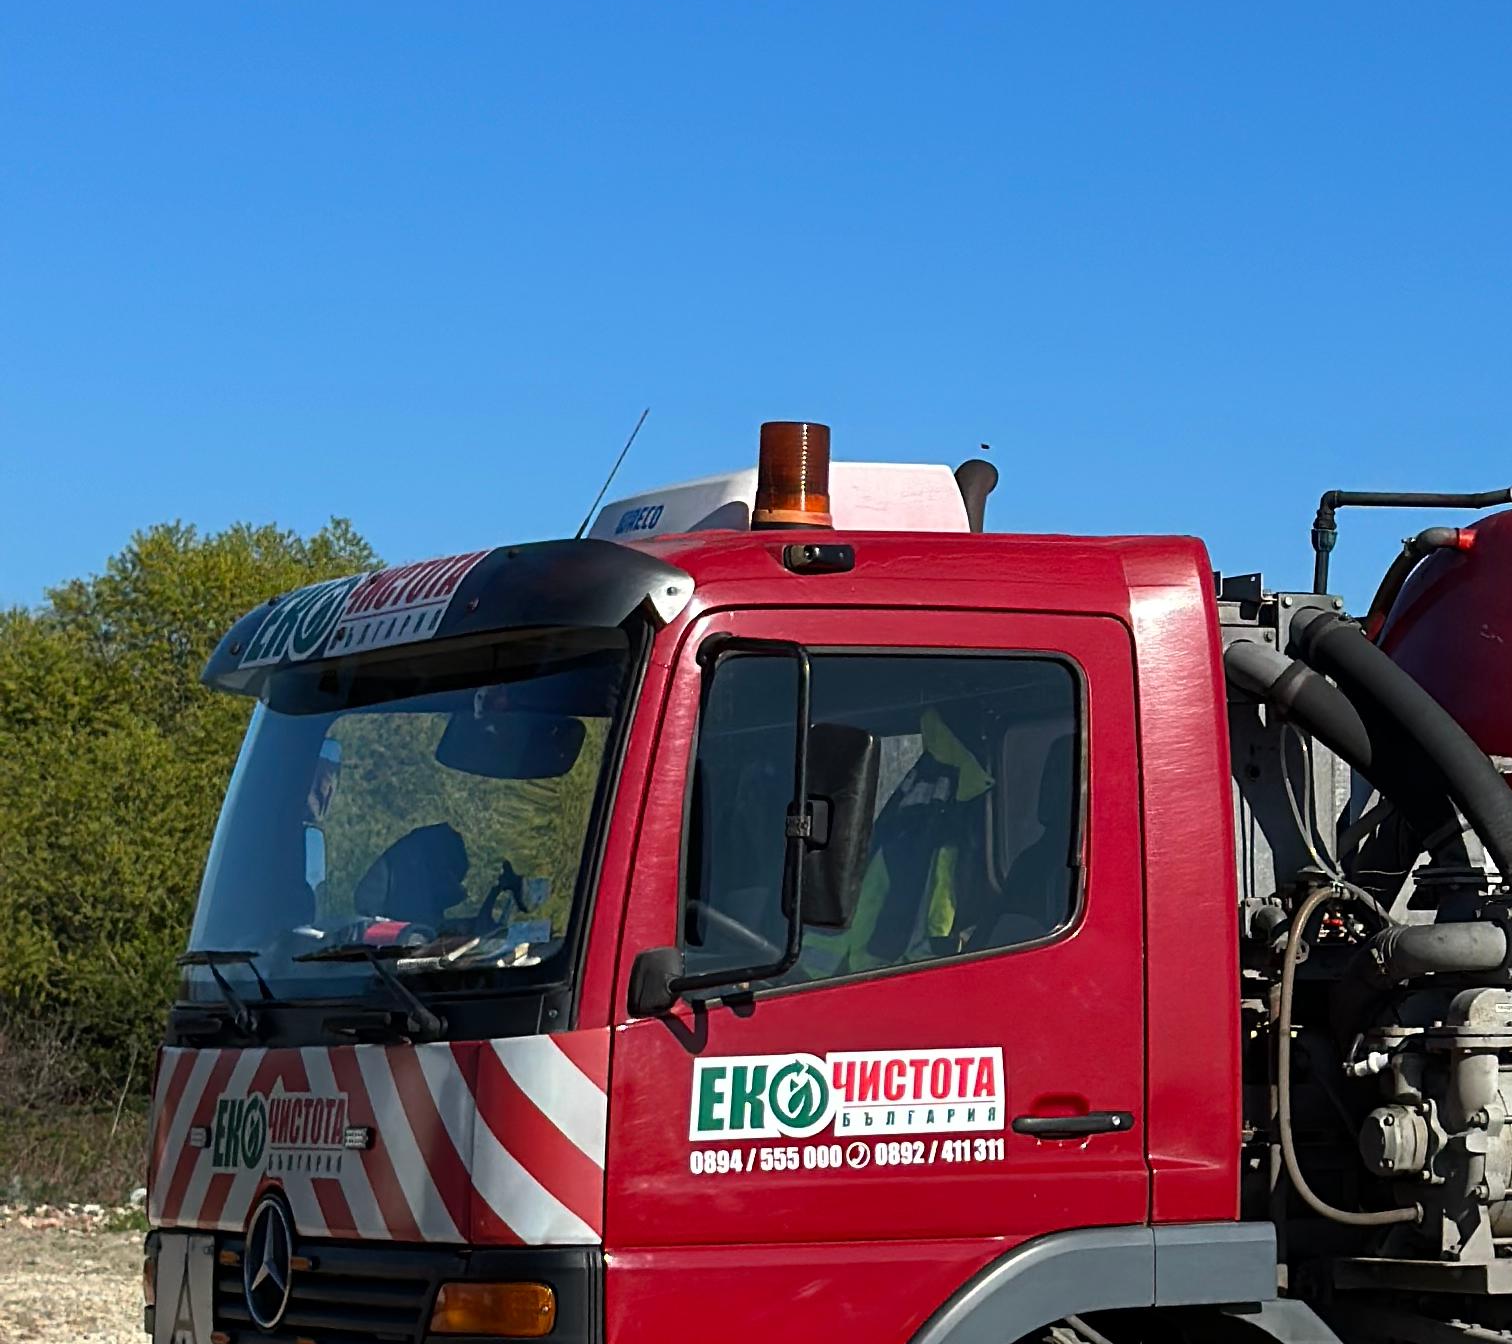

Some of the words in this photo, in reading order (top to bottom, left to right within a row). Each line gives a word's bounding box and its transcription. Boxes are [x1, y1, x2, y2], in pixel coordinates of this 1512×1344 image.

[697, 1059, 829, 1131] ЕКО
[832, 1057, 996, 1102] ЧИСТОТА
[843, 1107, 996, 1127] БЪЛГАРИЯ
[212, 1095, 267, 1169] ЕКО
[268, 1098, 345, 1144] ЧИСТОТА
[690, 1149, 743, 1174] 0894
[760, 1148, 800, 1171] 555
[804, 1145, 842, 1169] 000
[875, 1141, 925, 1166] 0892
[941, 1140, 972, 1163] 411
[973, 1138, 1005, 1161] 311
